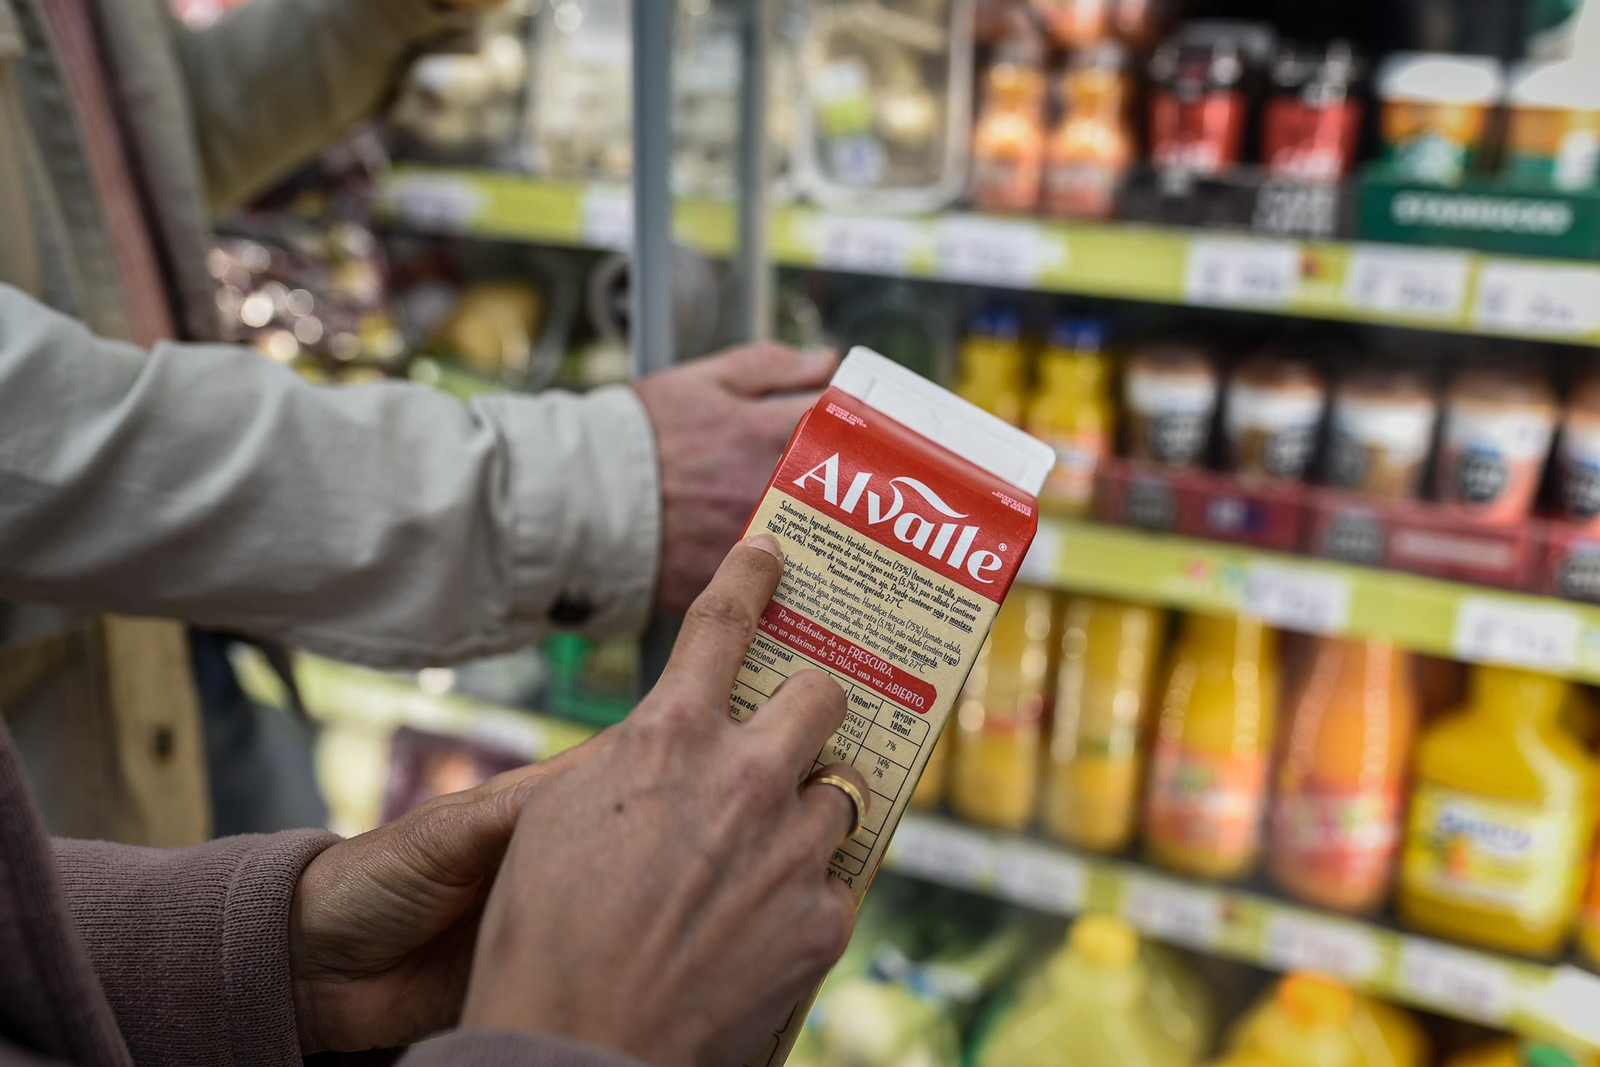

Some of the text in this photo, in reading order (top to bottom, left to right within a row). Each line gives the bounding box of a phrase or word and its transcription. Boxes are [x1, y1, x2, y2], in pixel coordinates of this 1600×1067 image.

[792, 452, 1008, 584] Alvalle
[774, 513, 977, 623] rojo, pepino), agua, aceite de oliva virgen extra (5,1%), pan rallado (contiene
[779, 499, 982, 613] Salmorejo. Ingredientes: Hortalizas frescas (75%) (tomate, cebolla, pimiento
[766, 519, 973, 634] trigo) (4,4%), vinagre de vino, sal marina, ajo. Puede contener soja y mostaza.
[826, 562, 855, 584] Mantener
[853, 578, 885, 600] refrigerado
[781, 568, 795, 582] elho,
[830, 595, 847, 608] azeite
[845, 603, 864, 620] virgem
[862, 613, 878, 625] extra
[905, 633, 923, 648] ralado
[941, 652, 961, 667] trigo)
[782, 554, 797, 570] base
[795, 561, 804, 574] de
[828, 579, 862, 604] Ingredientes:
[861, 596, 888, 618] Hortaliças
[886, 609, 906, 627] frescas
[905, 618, 925, 637] (75%)
[921, 627, 943, 647] (tomate,
[943, 640, 962, 656] cebola,
[778, 579, 799, 595] vinagre
[798, 588, 807, 600] de
[821, 602, 833, 612] sal
[829, 607, 854, 624] marinho,
[864, 622, 880, 638] Pode
[878, 633, 897, 646] conter
[894, 642, 908, 654] soja
[910, 650, 938, 670] mostarda.
[786, 597, 795, 606] no
[793, 601, 815, 616] máximo
[814, 609, 821, 619] 5
[818, 611, 831, 625] dias
[829, 620, 843, 631] após
[842, 624, 861, 641] aberto.
[860, 633, 881, 651] Manter
[879, 645, 909, 665] refrigerado
[746, 644, 777, 666] utricional
[755, 639, 794, 663] nutricional
[777, 608, 796, 627] Para
[795, 619, 827, 642] disfrutar
[826, 635, 837, 648] de
[837, 644, 847, 653] su
[846, 645, 894, 679] FRESCURA,
[741, 658, 763, 674] ético/
[767, 623, 925, 709] en un máximo de 5 DÍAS una vez ABIERTO.
[844, 712, 866, 729] 594 kJ
[849, 726, 864, 740] kcal
[889, 720, 912, 737] 180ml
[832, 745, 847, 761] 1,4 g
[835, 735, 852, 751] 9,5 g
[885, 739, 898, 752] 7%
[872, 766, 885, 779] 7%
[876, 756, 891, 770] 14%
